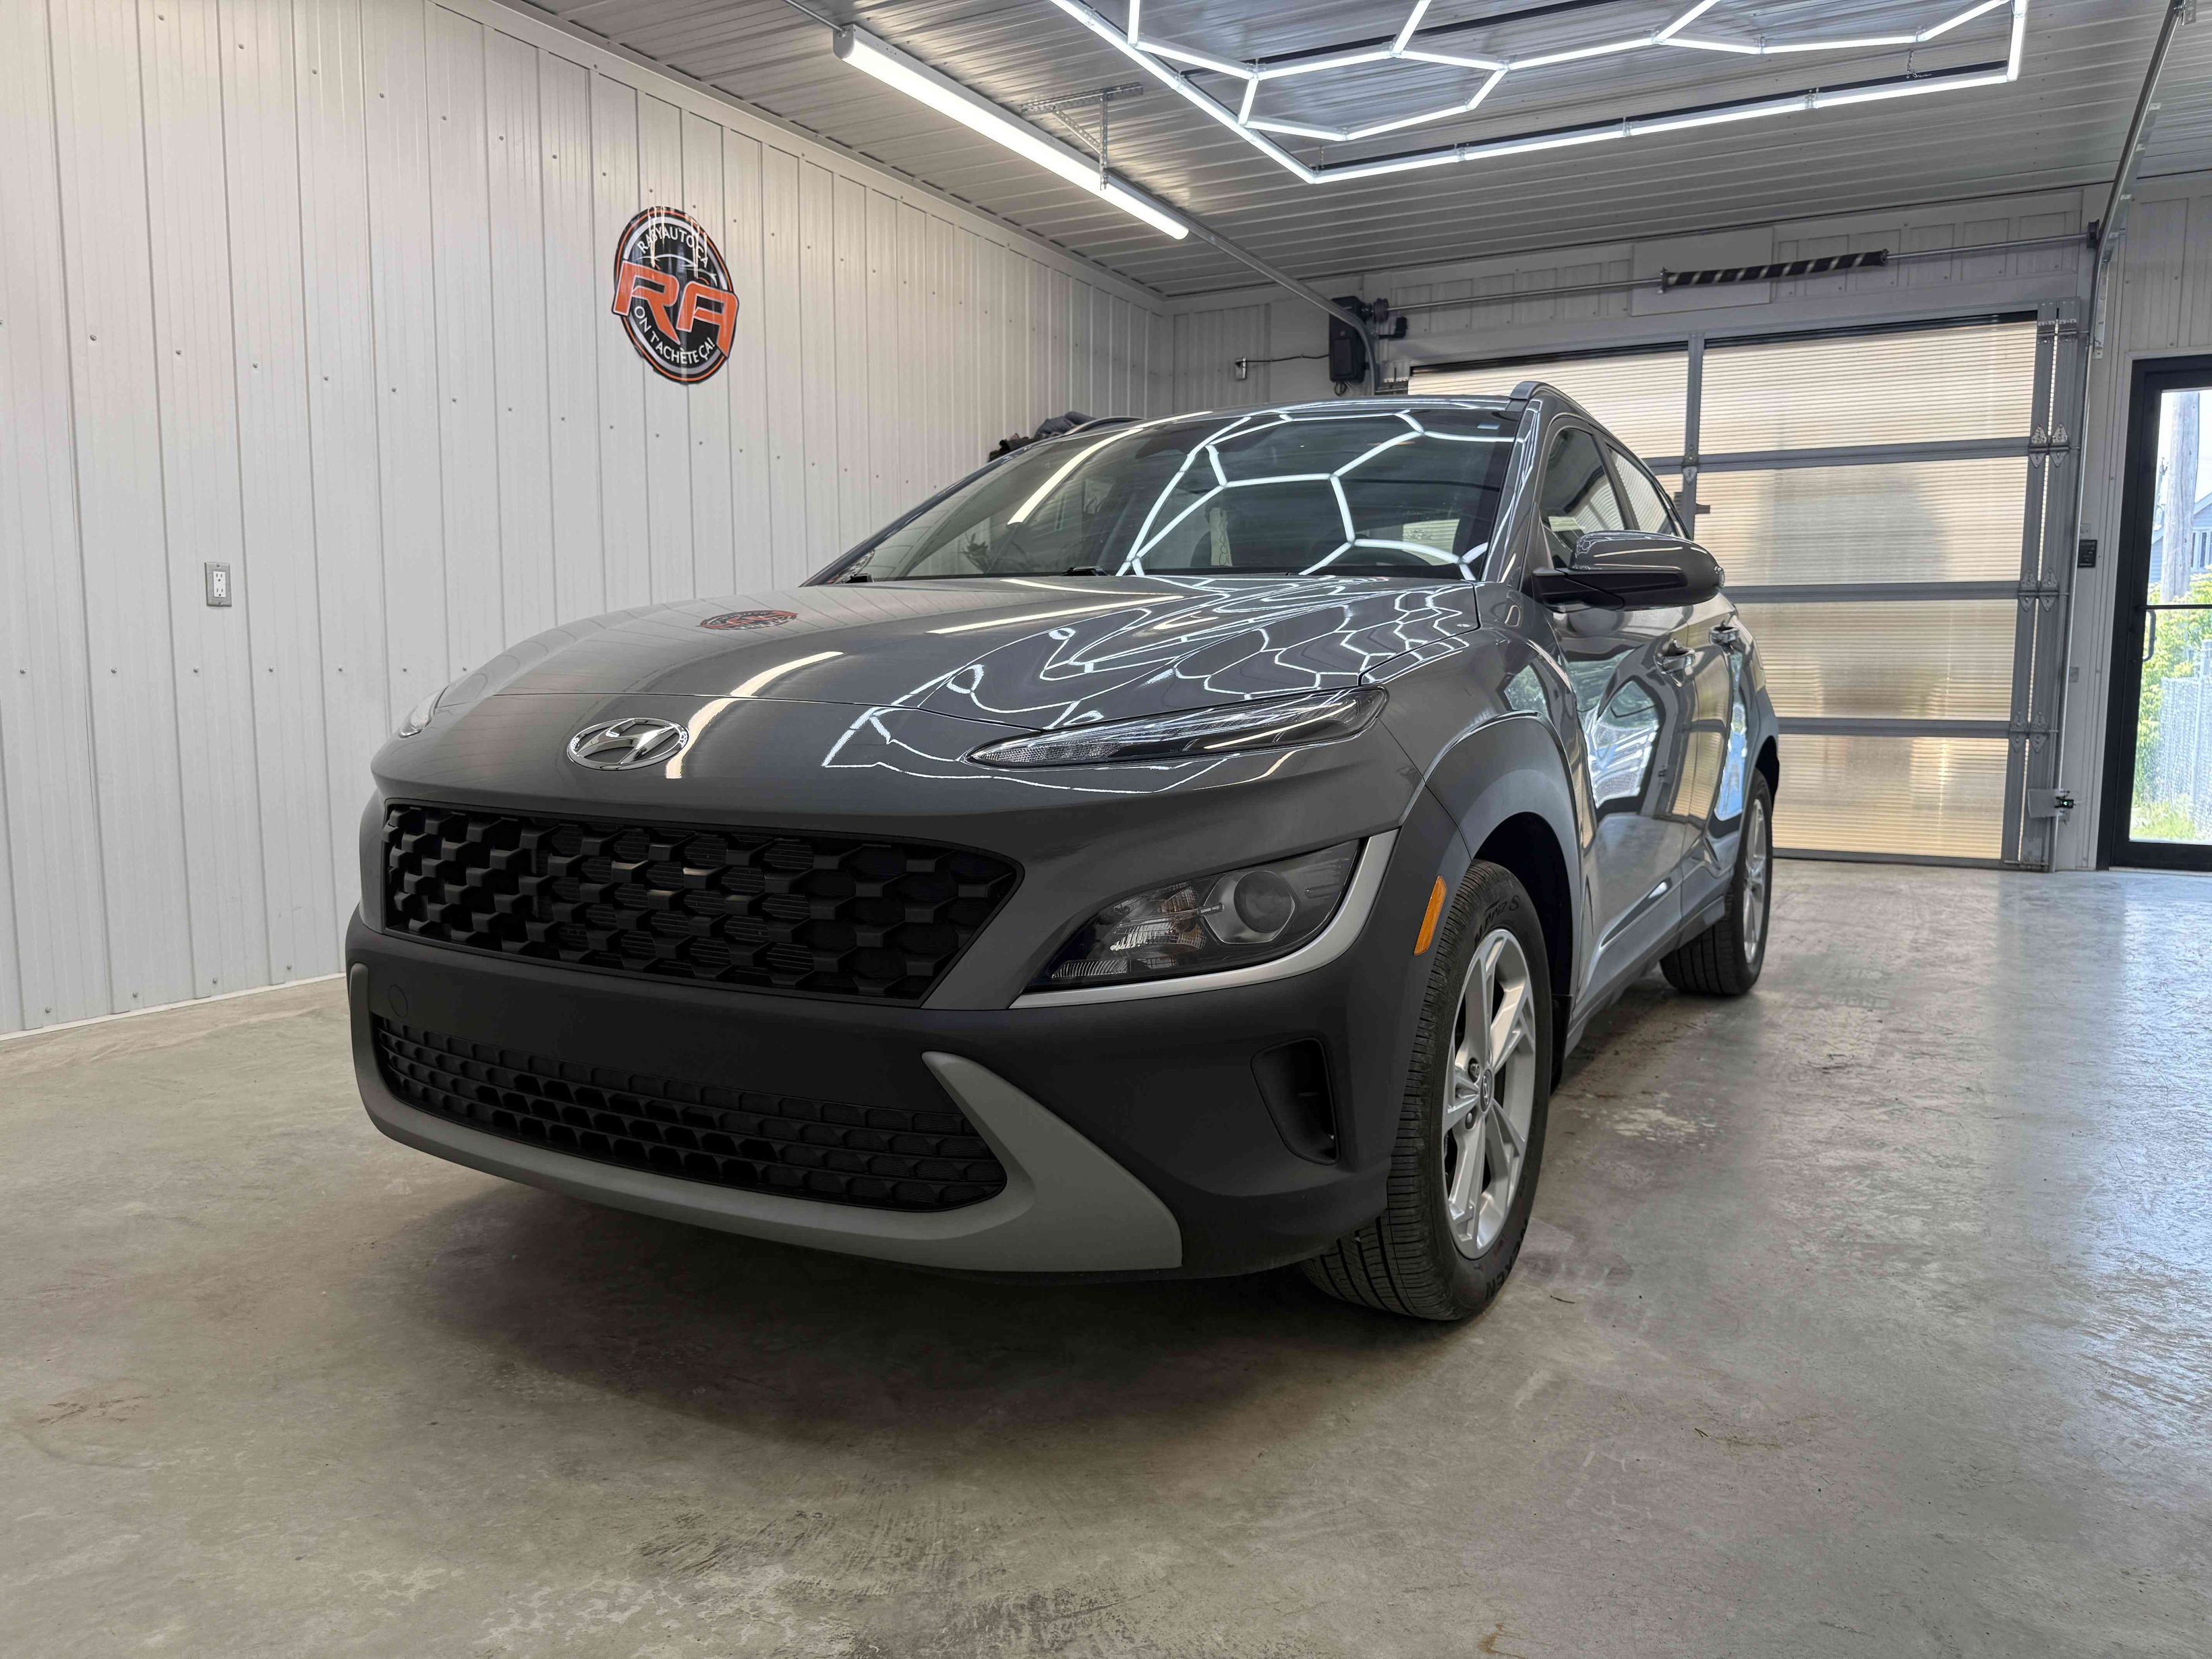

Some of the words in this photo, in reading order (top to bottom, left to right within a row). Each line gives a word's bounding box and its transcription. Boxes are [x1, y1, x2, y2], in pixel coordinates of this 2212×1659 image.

[612, 260, 739, 357] RA
[634, 305, 652, 333] ON
[699, 337, 716, 361] ÇA!
